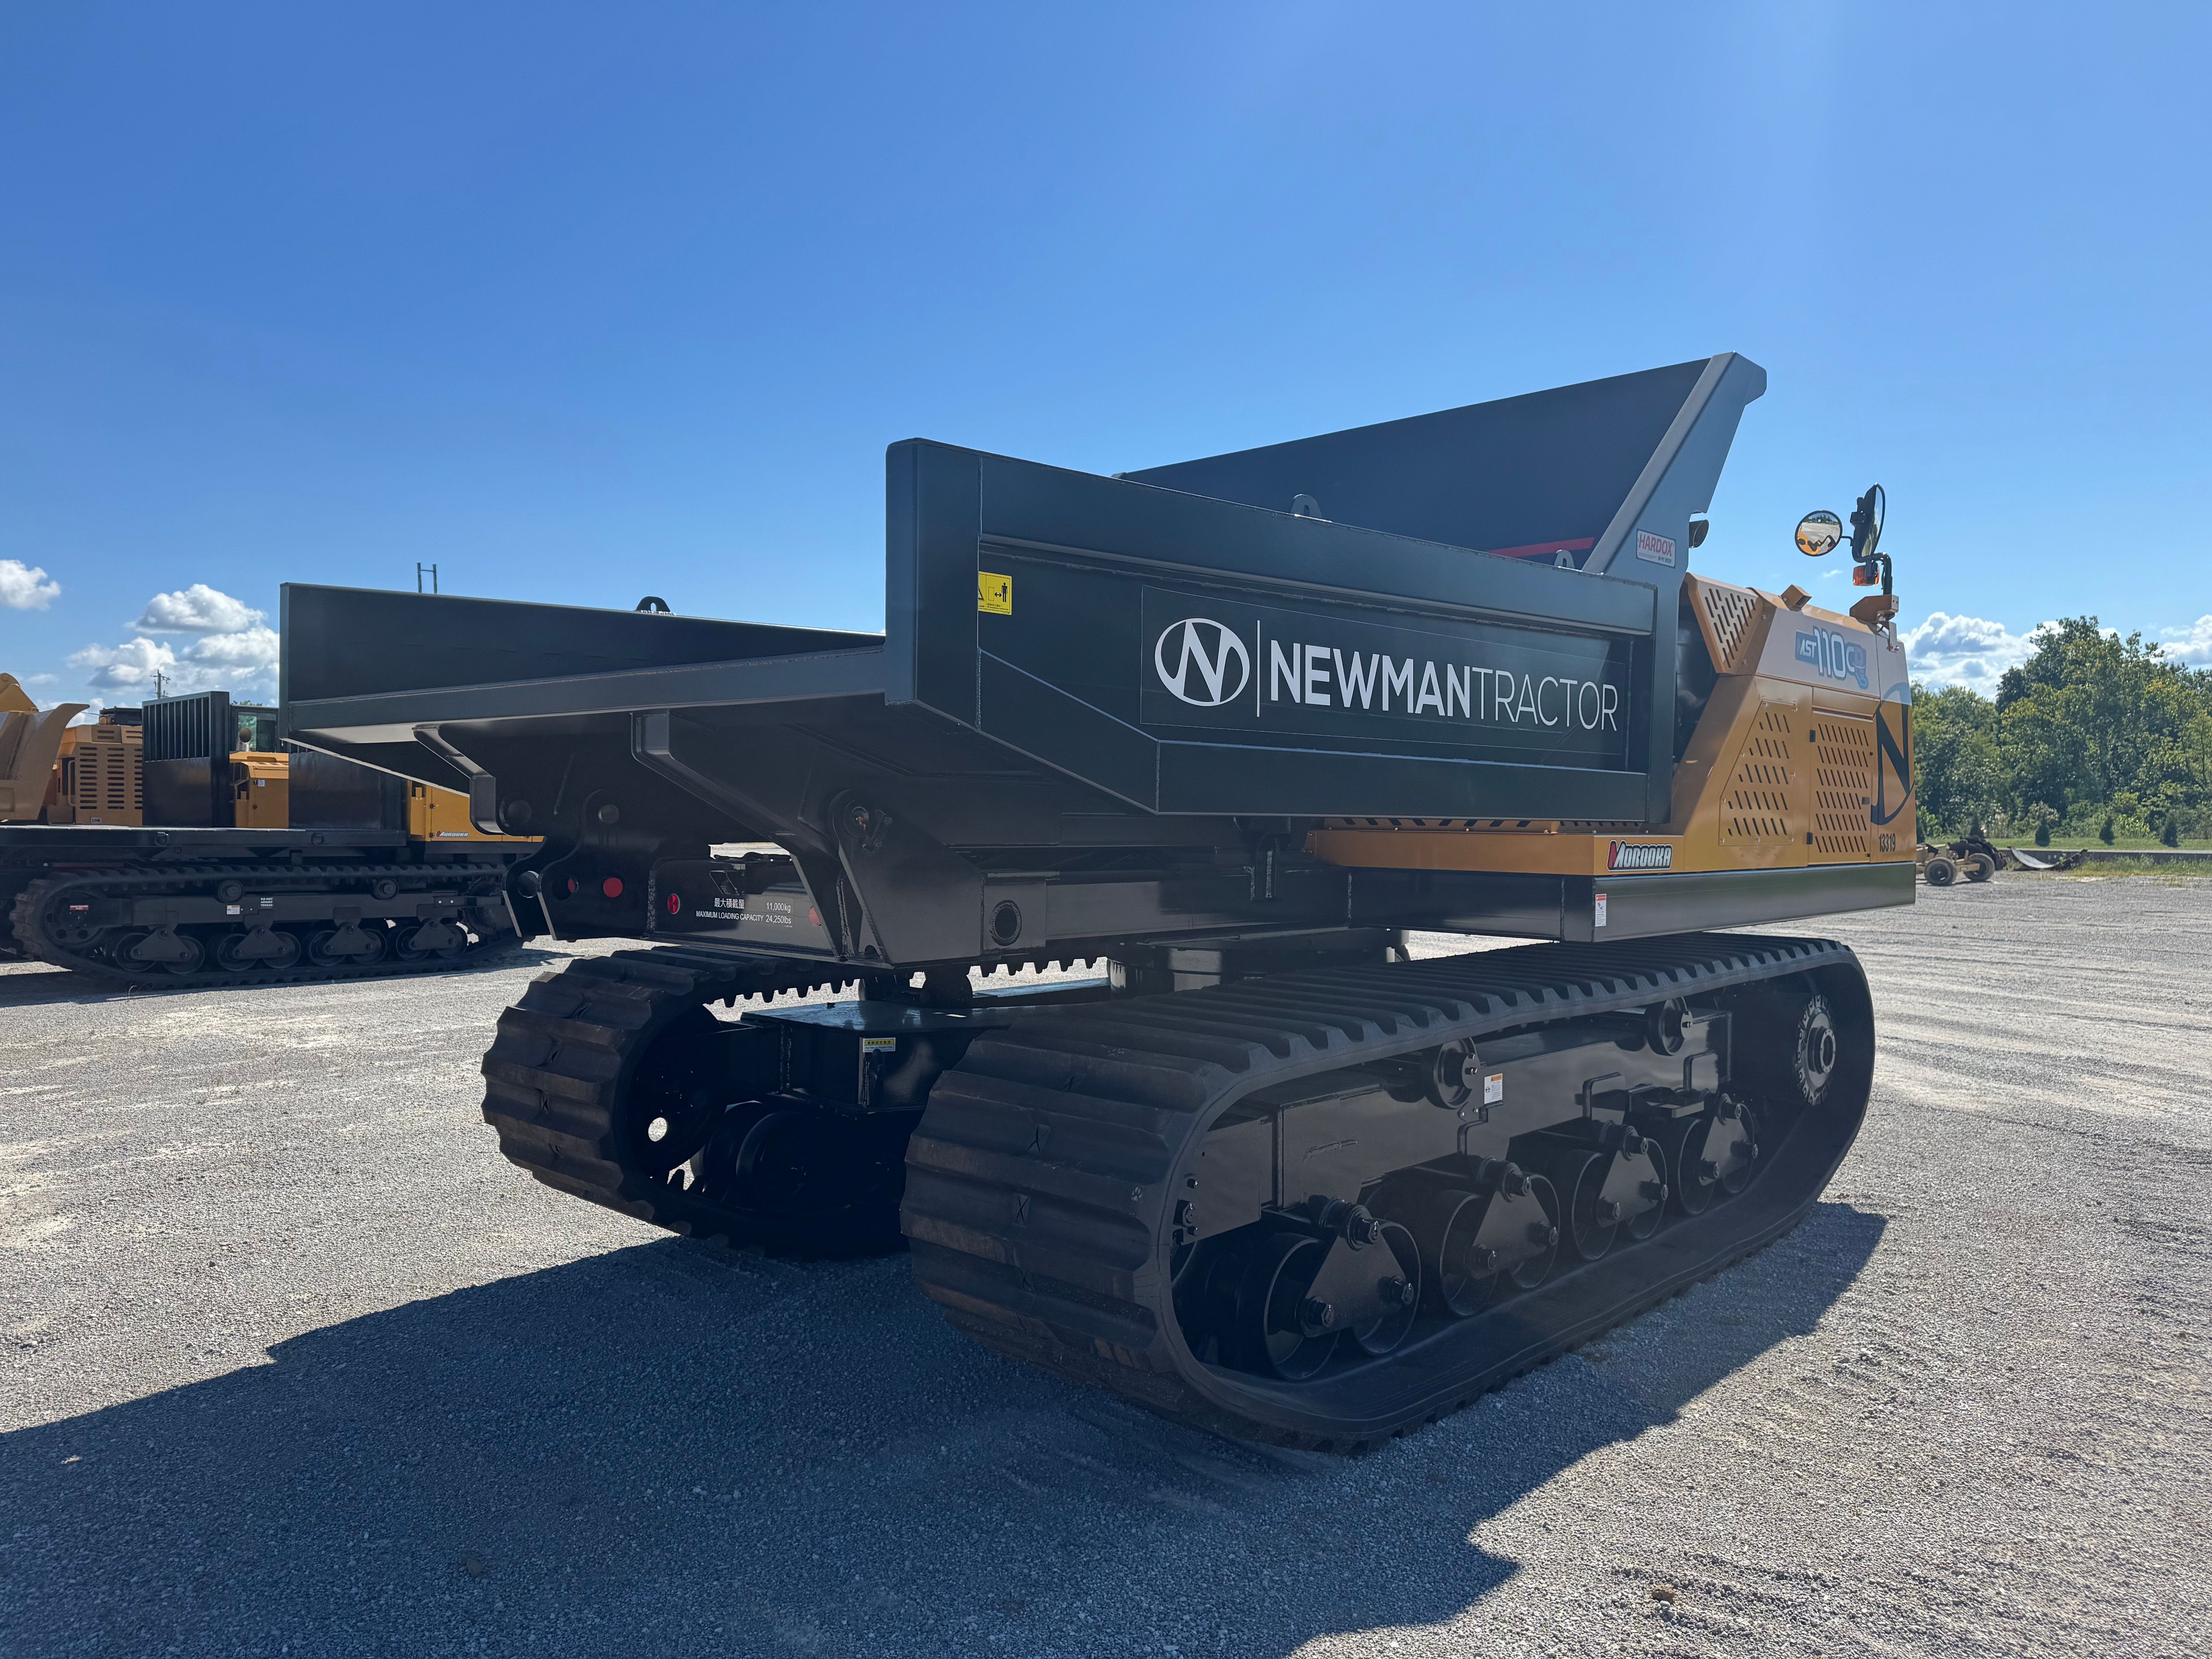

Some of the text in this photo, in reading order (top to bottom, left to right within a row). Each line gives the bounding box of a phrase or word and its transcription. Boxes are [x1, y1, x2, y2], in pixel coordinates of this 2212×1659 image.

[1639, 533, 1673, 556] HARDOX
[1879, 833, 1896, 852] 13319
[1608, 842, 1672, 868] MOROOKA
[714, 898, 745, 909] 最大積載量
[766, 902, 791, 913] 11,000kg
[766, 915, 791, 924] 24,250lbs
